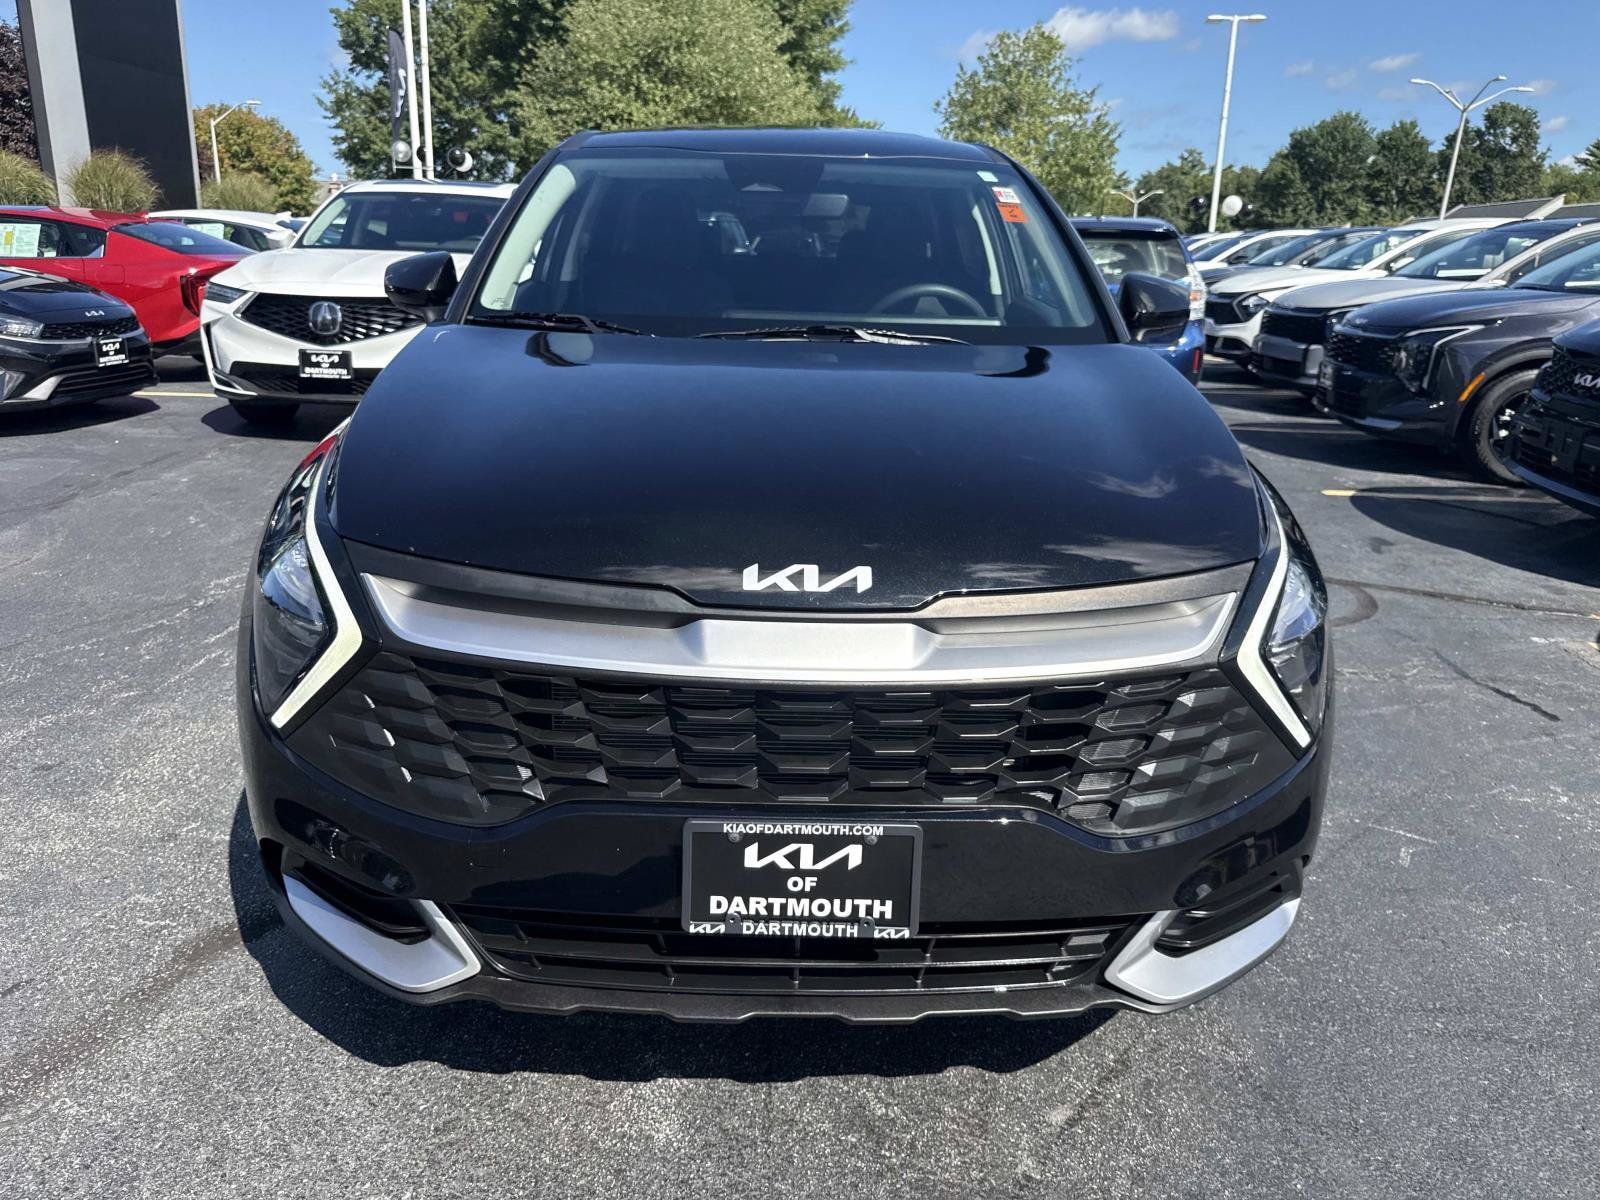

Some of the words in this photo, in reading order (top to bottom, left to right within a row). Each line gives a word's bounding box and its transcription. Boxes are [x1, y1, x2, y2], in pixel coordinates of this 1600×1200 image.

[310, 354, 340, 363] KIA
[742, 563, 873, 594] KIA
[723, 823, 884, 836] KIAOFDARTMOUTH.COM
[744, 841, 863, 871] KIA
[786, 876, 818, 892] OF
[709, 895, 893, 920] DARTMOUTH
[689, 923, 726, 934] KIA
[742, 922, 858, 938] DARTMOUTH
[873, 928, 910, 940] KIA
